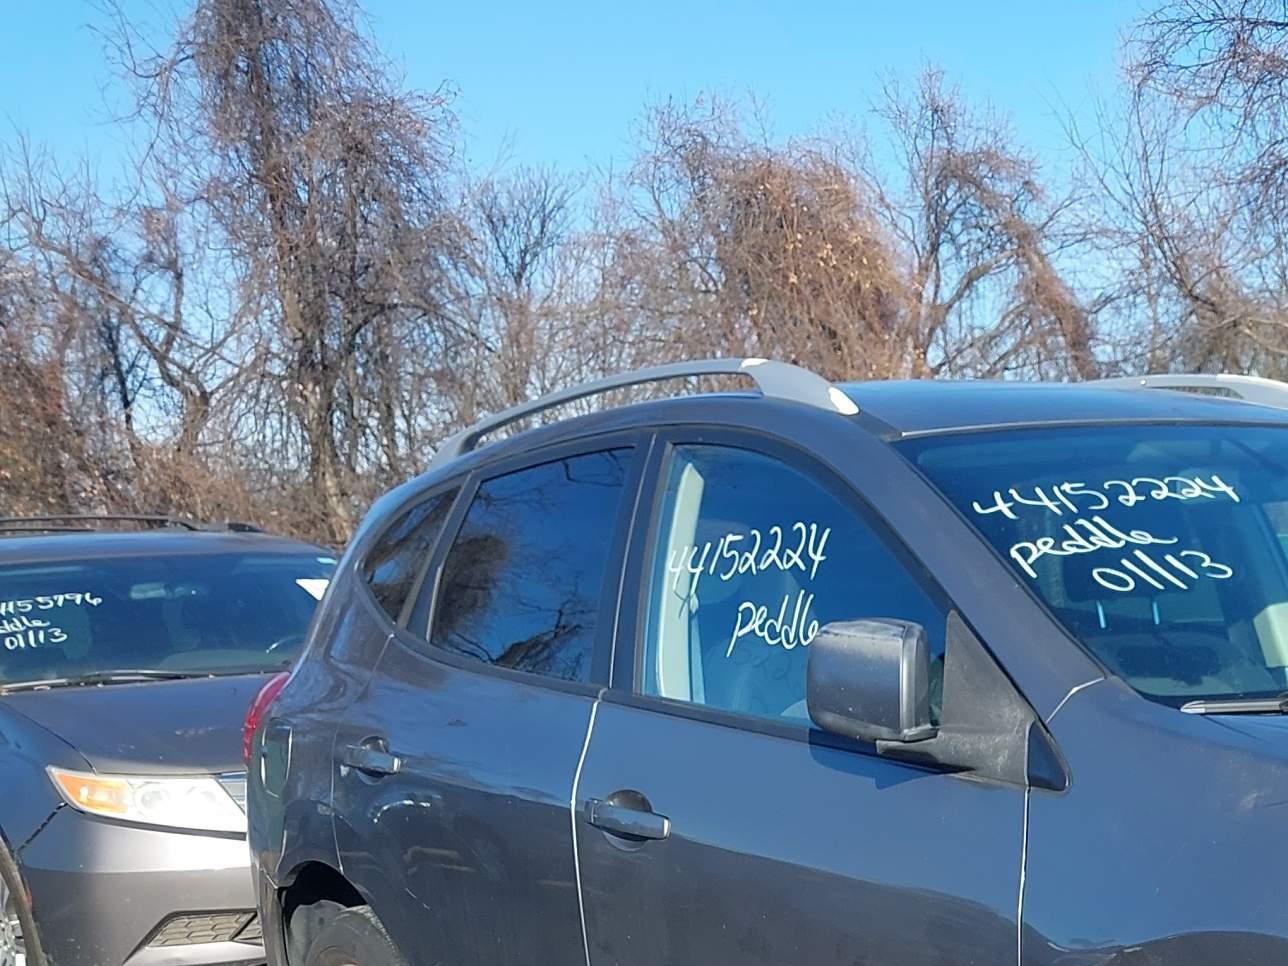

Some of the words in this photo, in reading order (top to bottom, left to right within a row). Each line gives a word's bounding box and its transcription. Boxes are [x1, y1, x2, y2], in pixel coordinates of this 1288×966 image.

[972, 475, 1240, 520] 44152224
[668, 521, 831, 594] 44152224
[1010, 515, 1178, 578] peddle
[1092, 550, 1233, 592] 01/13
[726, 590, 819, 658] peddle
